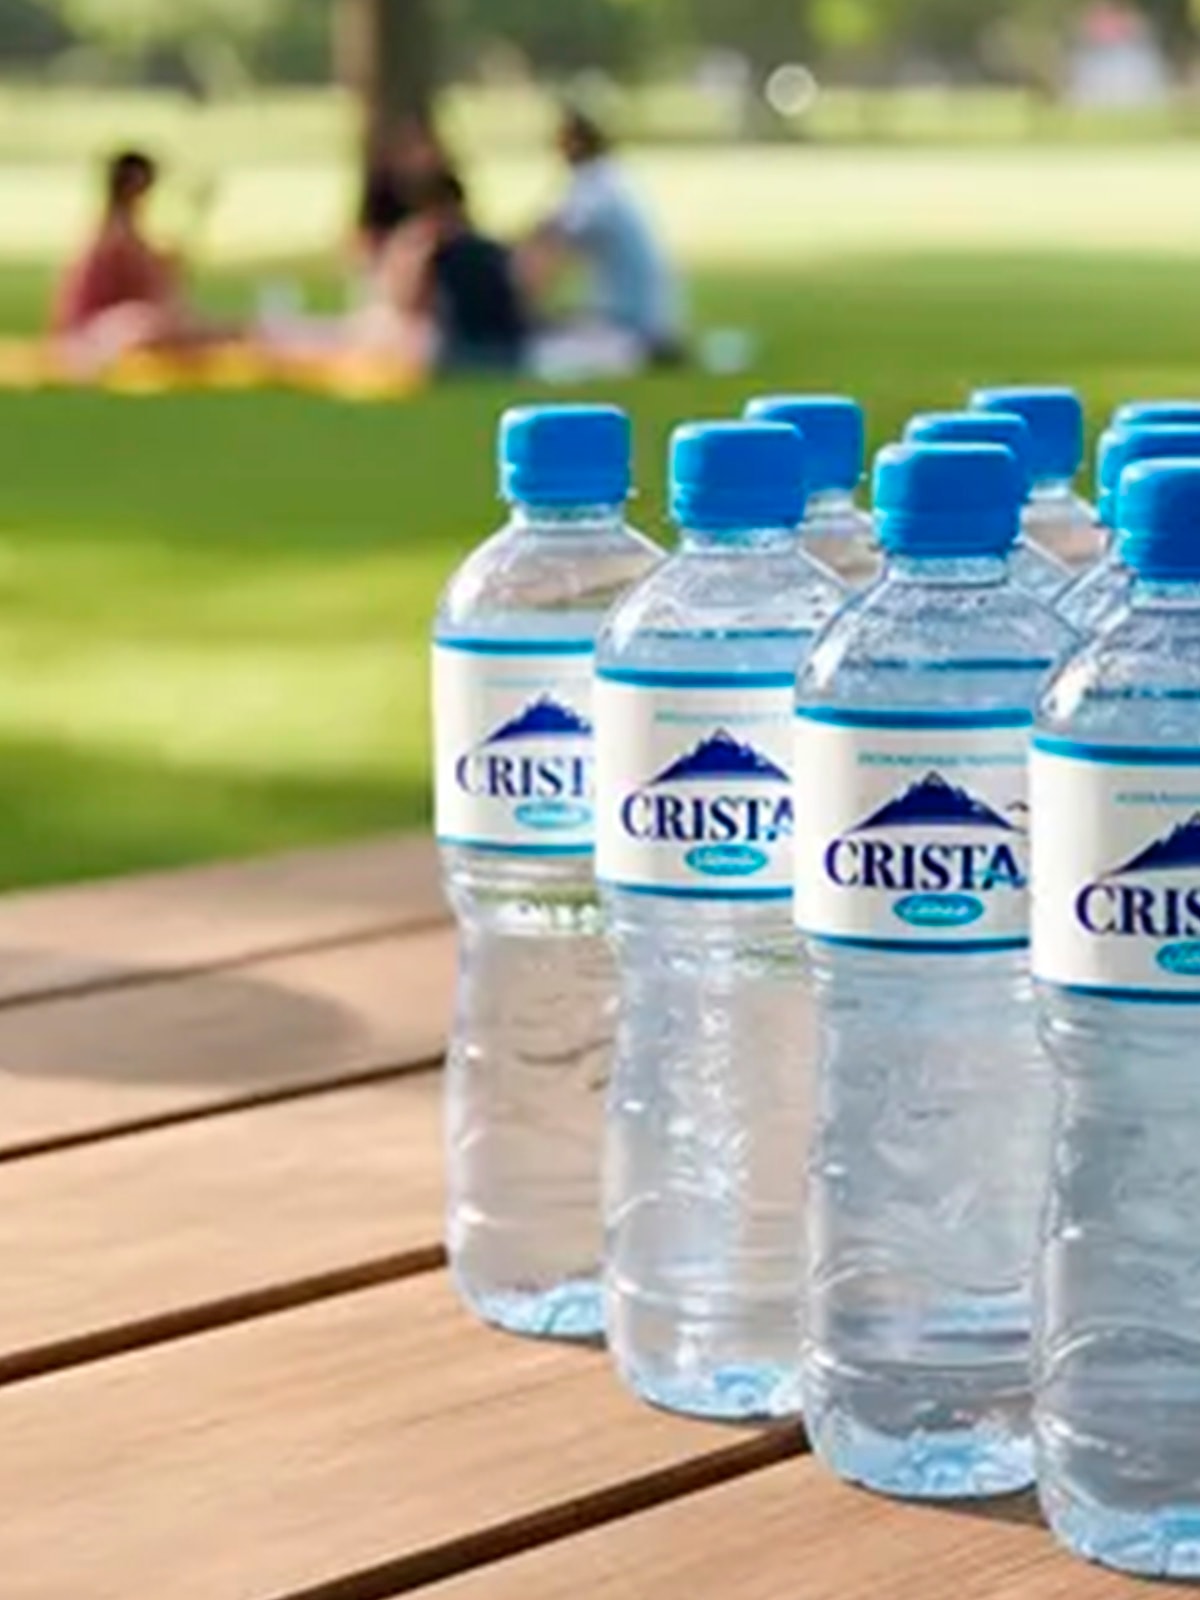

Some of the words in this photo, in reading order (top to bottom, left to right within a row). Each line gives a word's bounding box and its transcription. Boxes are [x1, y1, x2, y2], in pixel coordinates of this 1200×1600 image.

[455, 753, 590, 797] CRIST
[620, 789, 794, 842] CRISTA
[824, 838, 1028, 891] CRISTA
